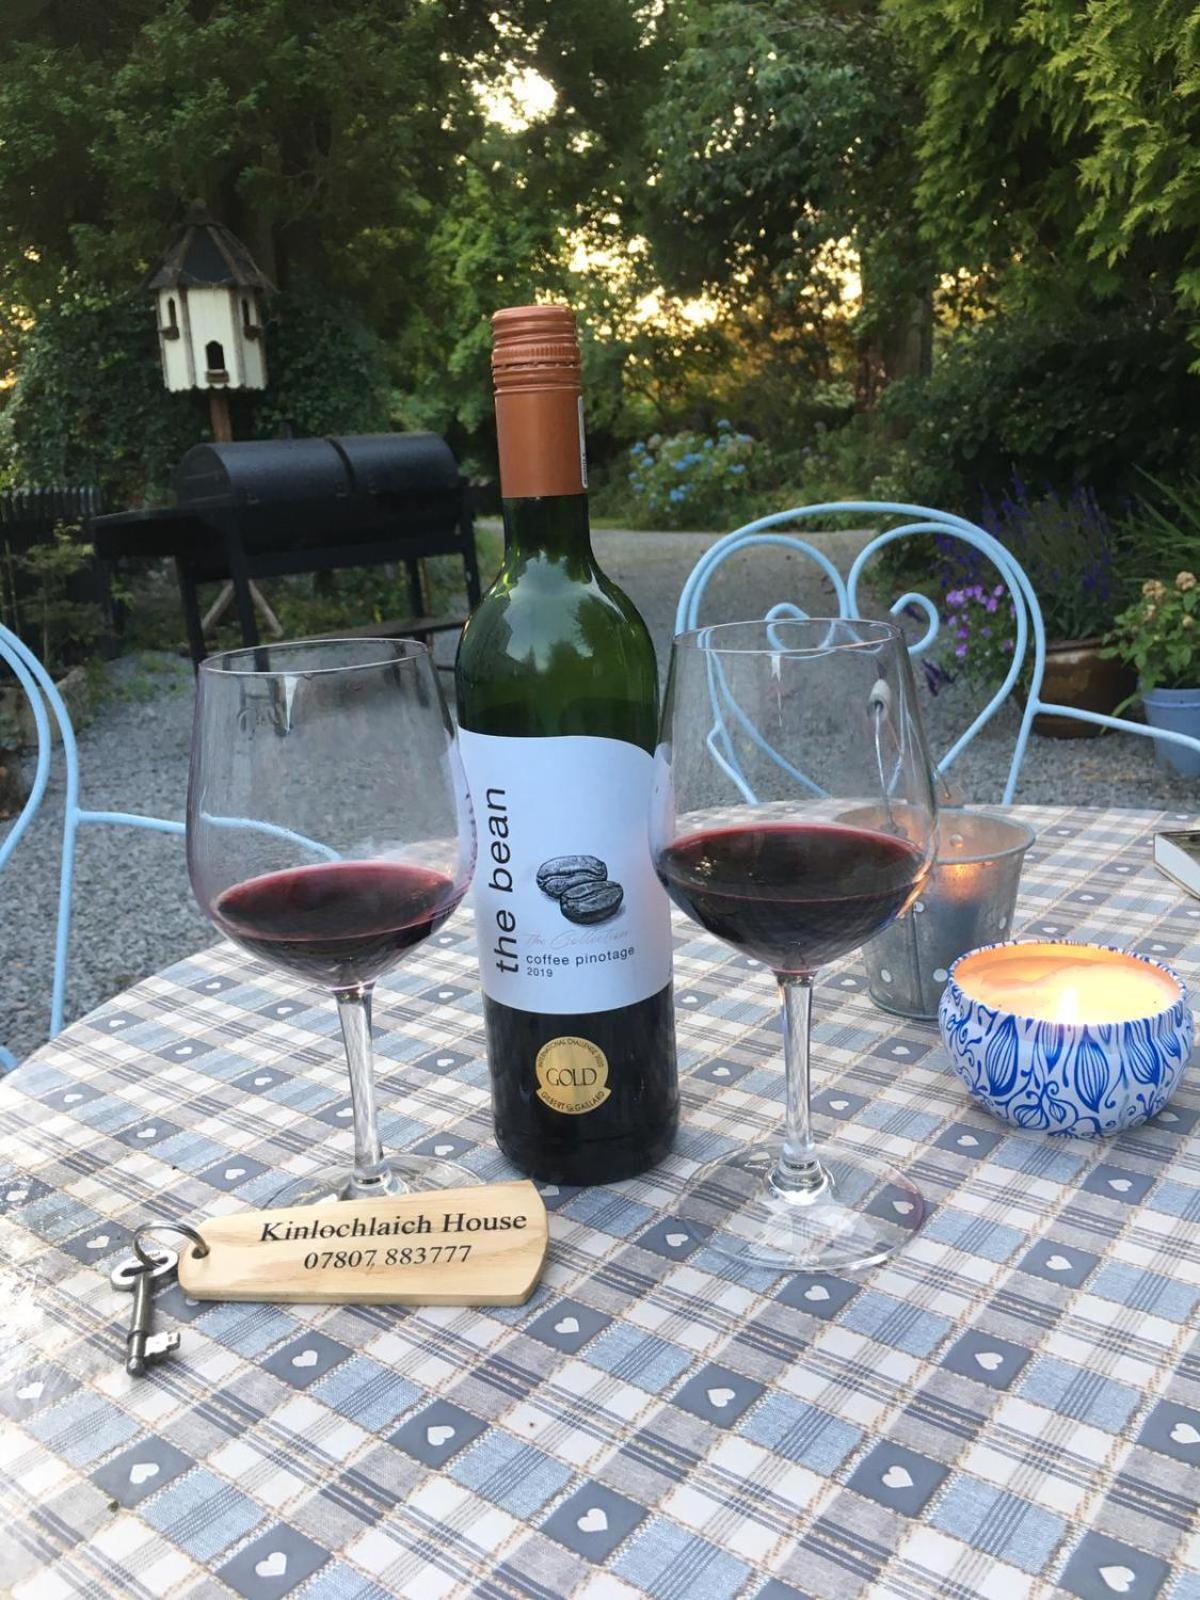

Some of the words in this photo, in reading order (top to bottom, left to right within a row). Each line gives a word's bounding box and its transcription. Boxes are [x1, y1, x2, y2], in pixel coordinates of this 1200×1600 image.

[486, 787, 513, 893] bean
[493, 909, 519, 974] the
[526, 954, 570, 966] coffee
[575, 946, 635, 968] pinotage
[526, 967, 554, 978] 2019
[545, 1067, 598, 1087] GOLD
[258, 1213, 433, 1243] Kinlochlaich
[441, 1213, 528, 1234] House
[303, 1250, 377, 1270] 07807
[384, 1244, 473, 1266] 883777
